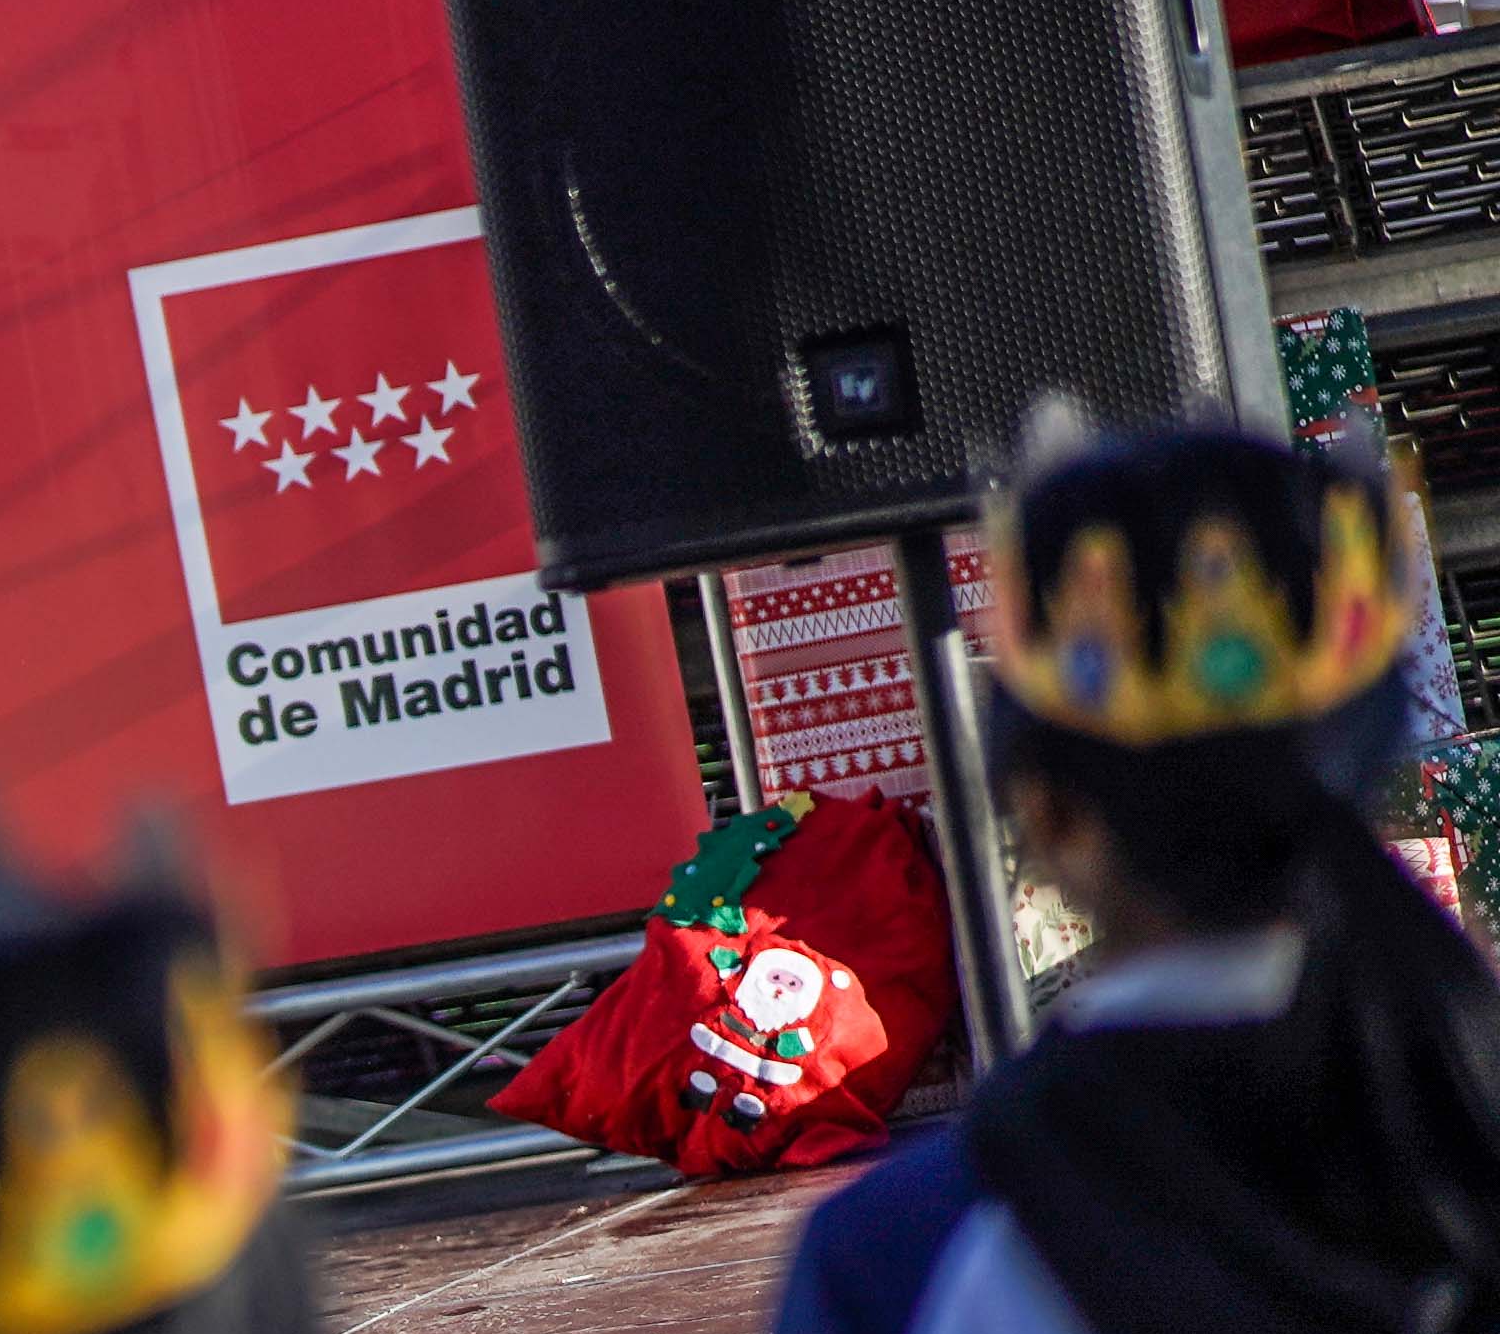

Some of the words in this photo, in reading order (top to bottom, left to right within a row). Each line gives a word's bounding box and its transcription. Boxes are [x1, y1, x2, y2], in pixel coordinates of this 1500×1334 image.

[226, 590, 567, 688] Comunidad
[237, 695, 320, 746] de
[338, 643, 576, 729] Madrid
